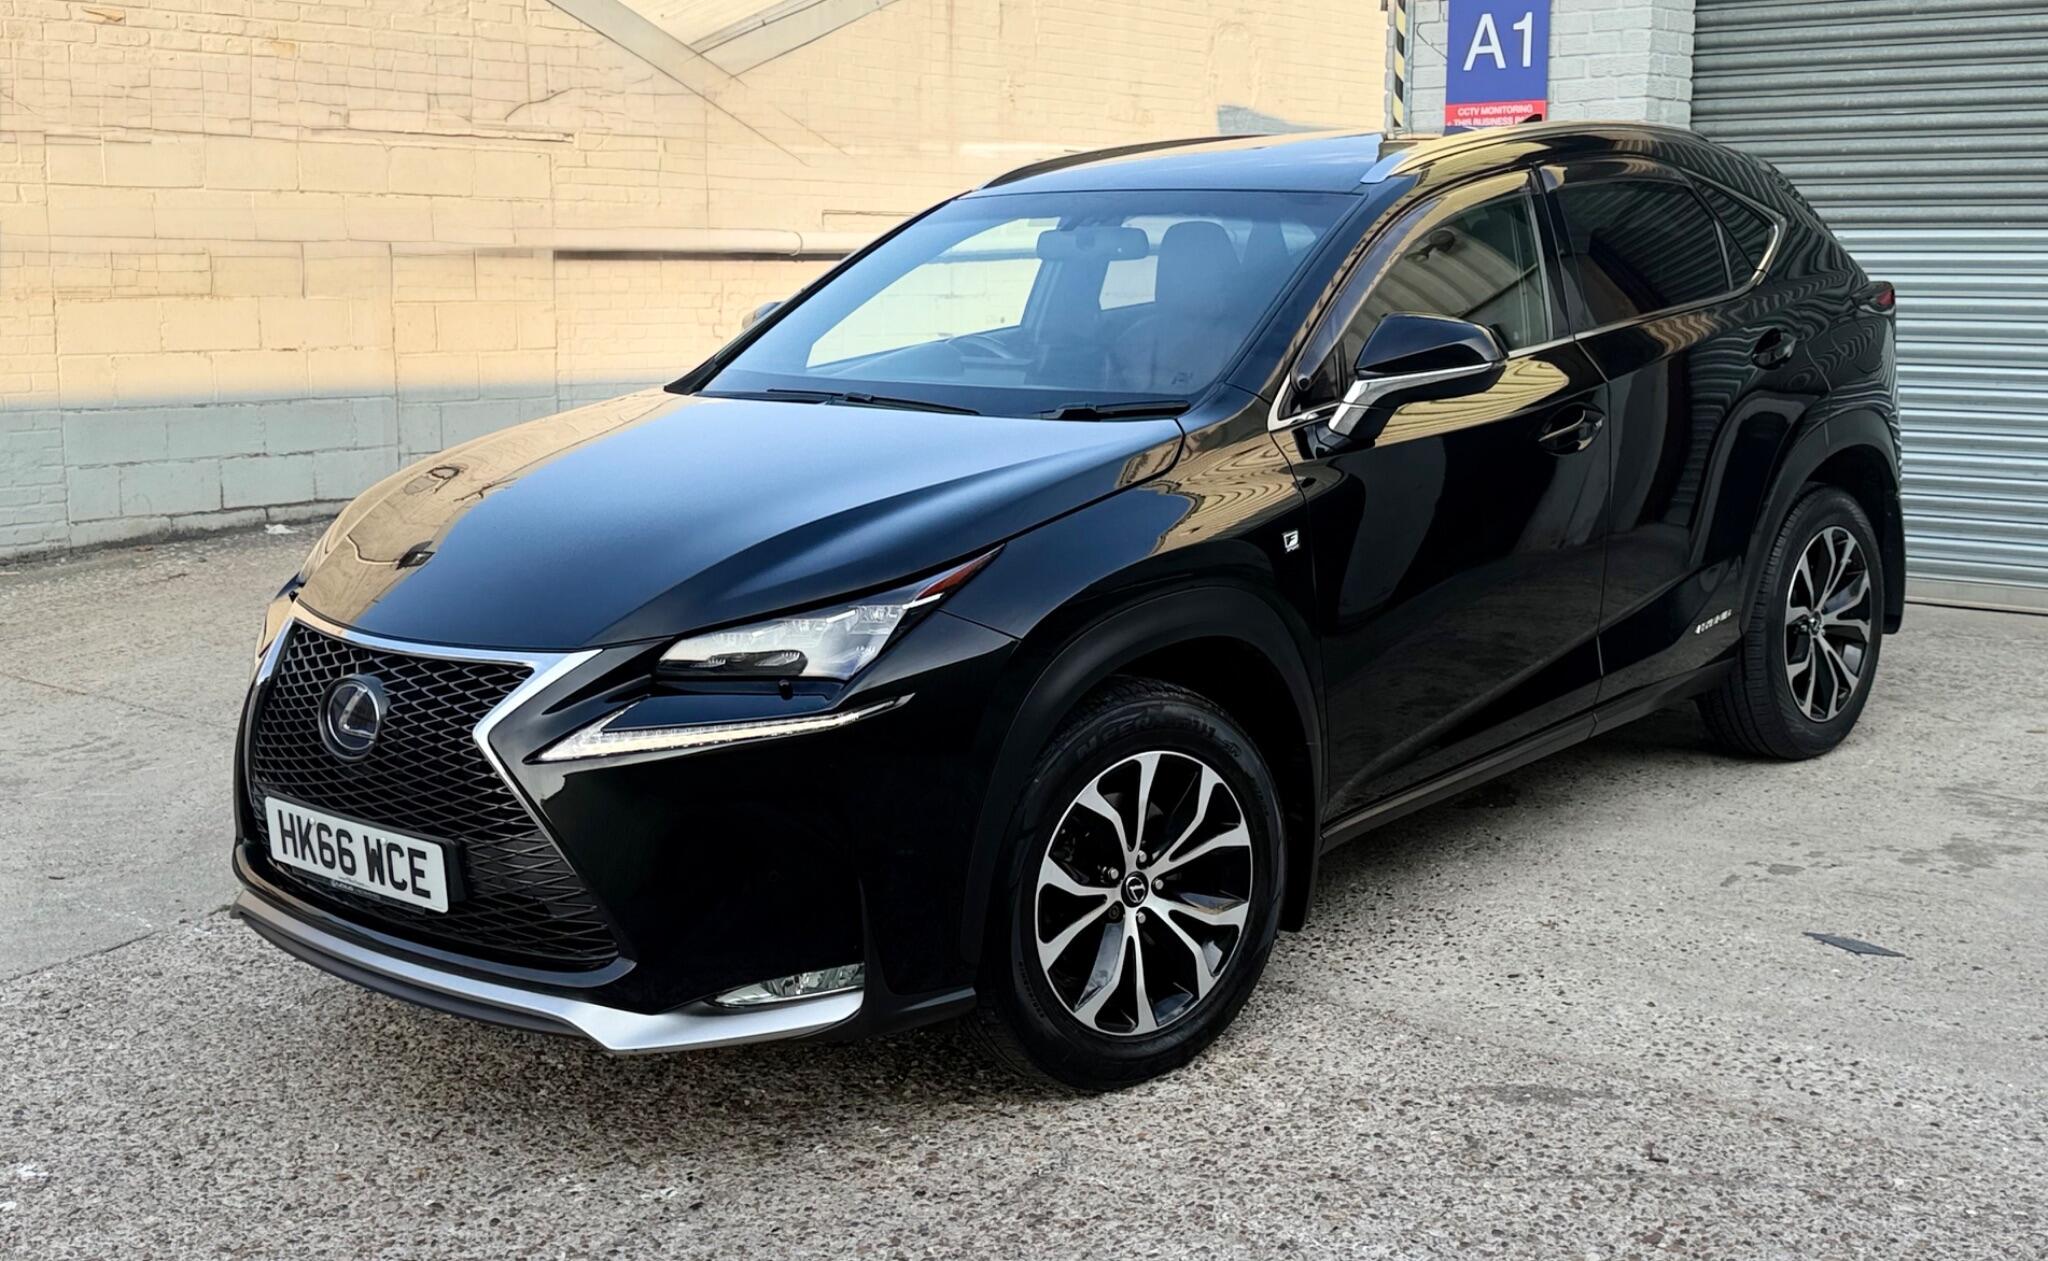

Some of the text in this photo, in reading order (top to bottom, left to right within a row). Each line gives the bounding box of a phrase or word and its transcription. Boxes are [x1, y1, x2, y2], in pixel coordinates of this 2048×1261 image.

[1463, 11, 1533, 71] A1
[1457, 104, 1534, 117] CCTV MONITORING
[1472, 115, 1514, 127] BUSINESS
[277, 809, 431, 900] HK66 WCE
